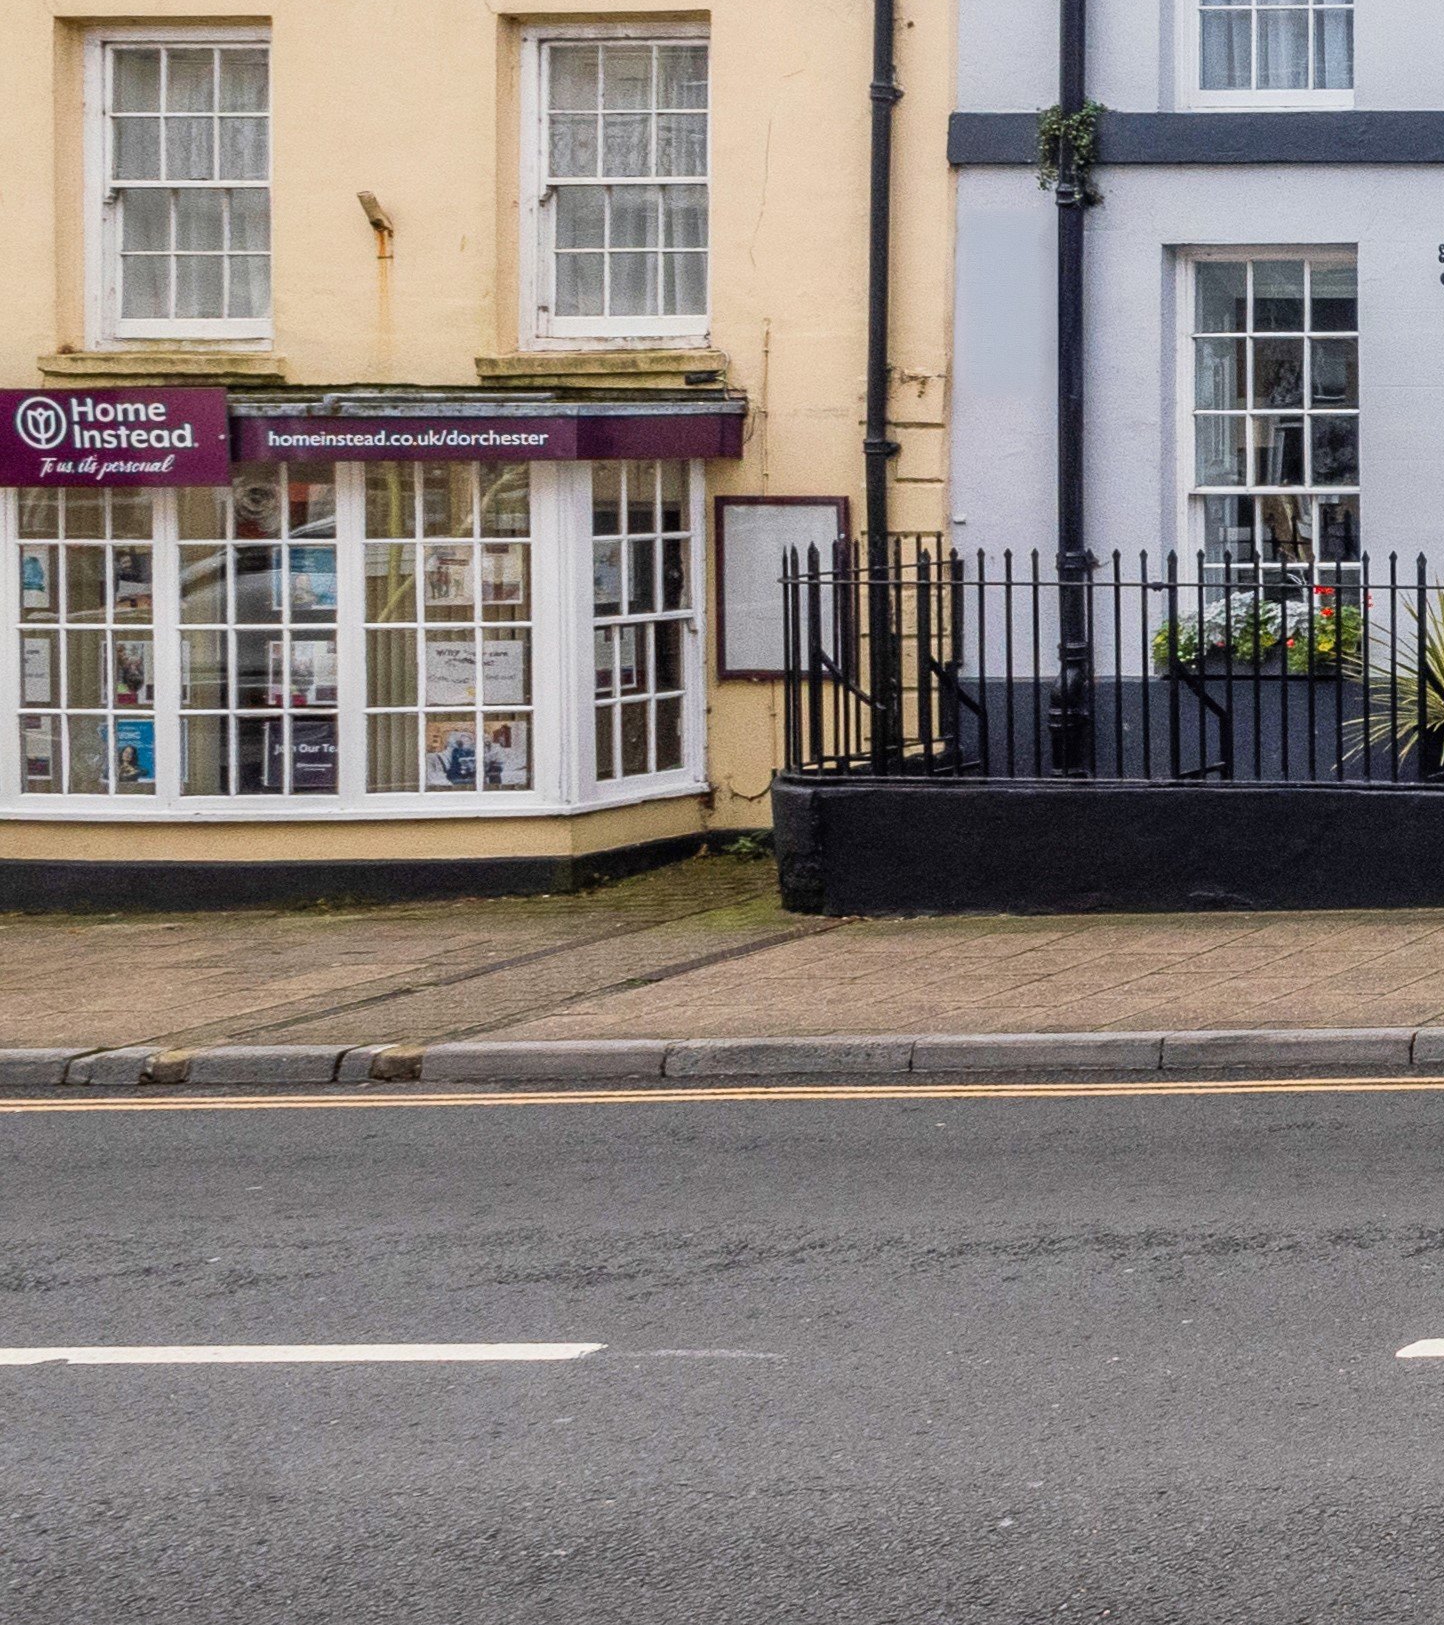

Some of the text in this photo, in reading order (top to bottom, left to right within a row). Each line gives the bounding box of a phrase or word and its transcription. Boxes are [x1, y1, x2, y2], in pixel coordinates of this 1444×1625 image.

[70, 397, 167, 422] Home
[268, 430, 549, 447] homeinstead.co.uk/dorchester
[96, 453, 176, 480] personal
[299, 743, 320, 754] Our
[322, 743, 339, 754] Te
